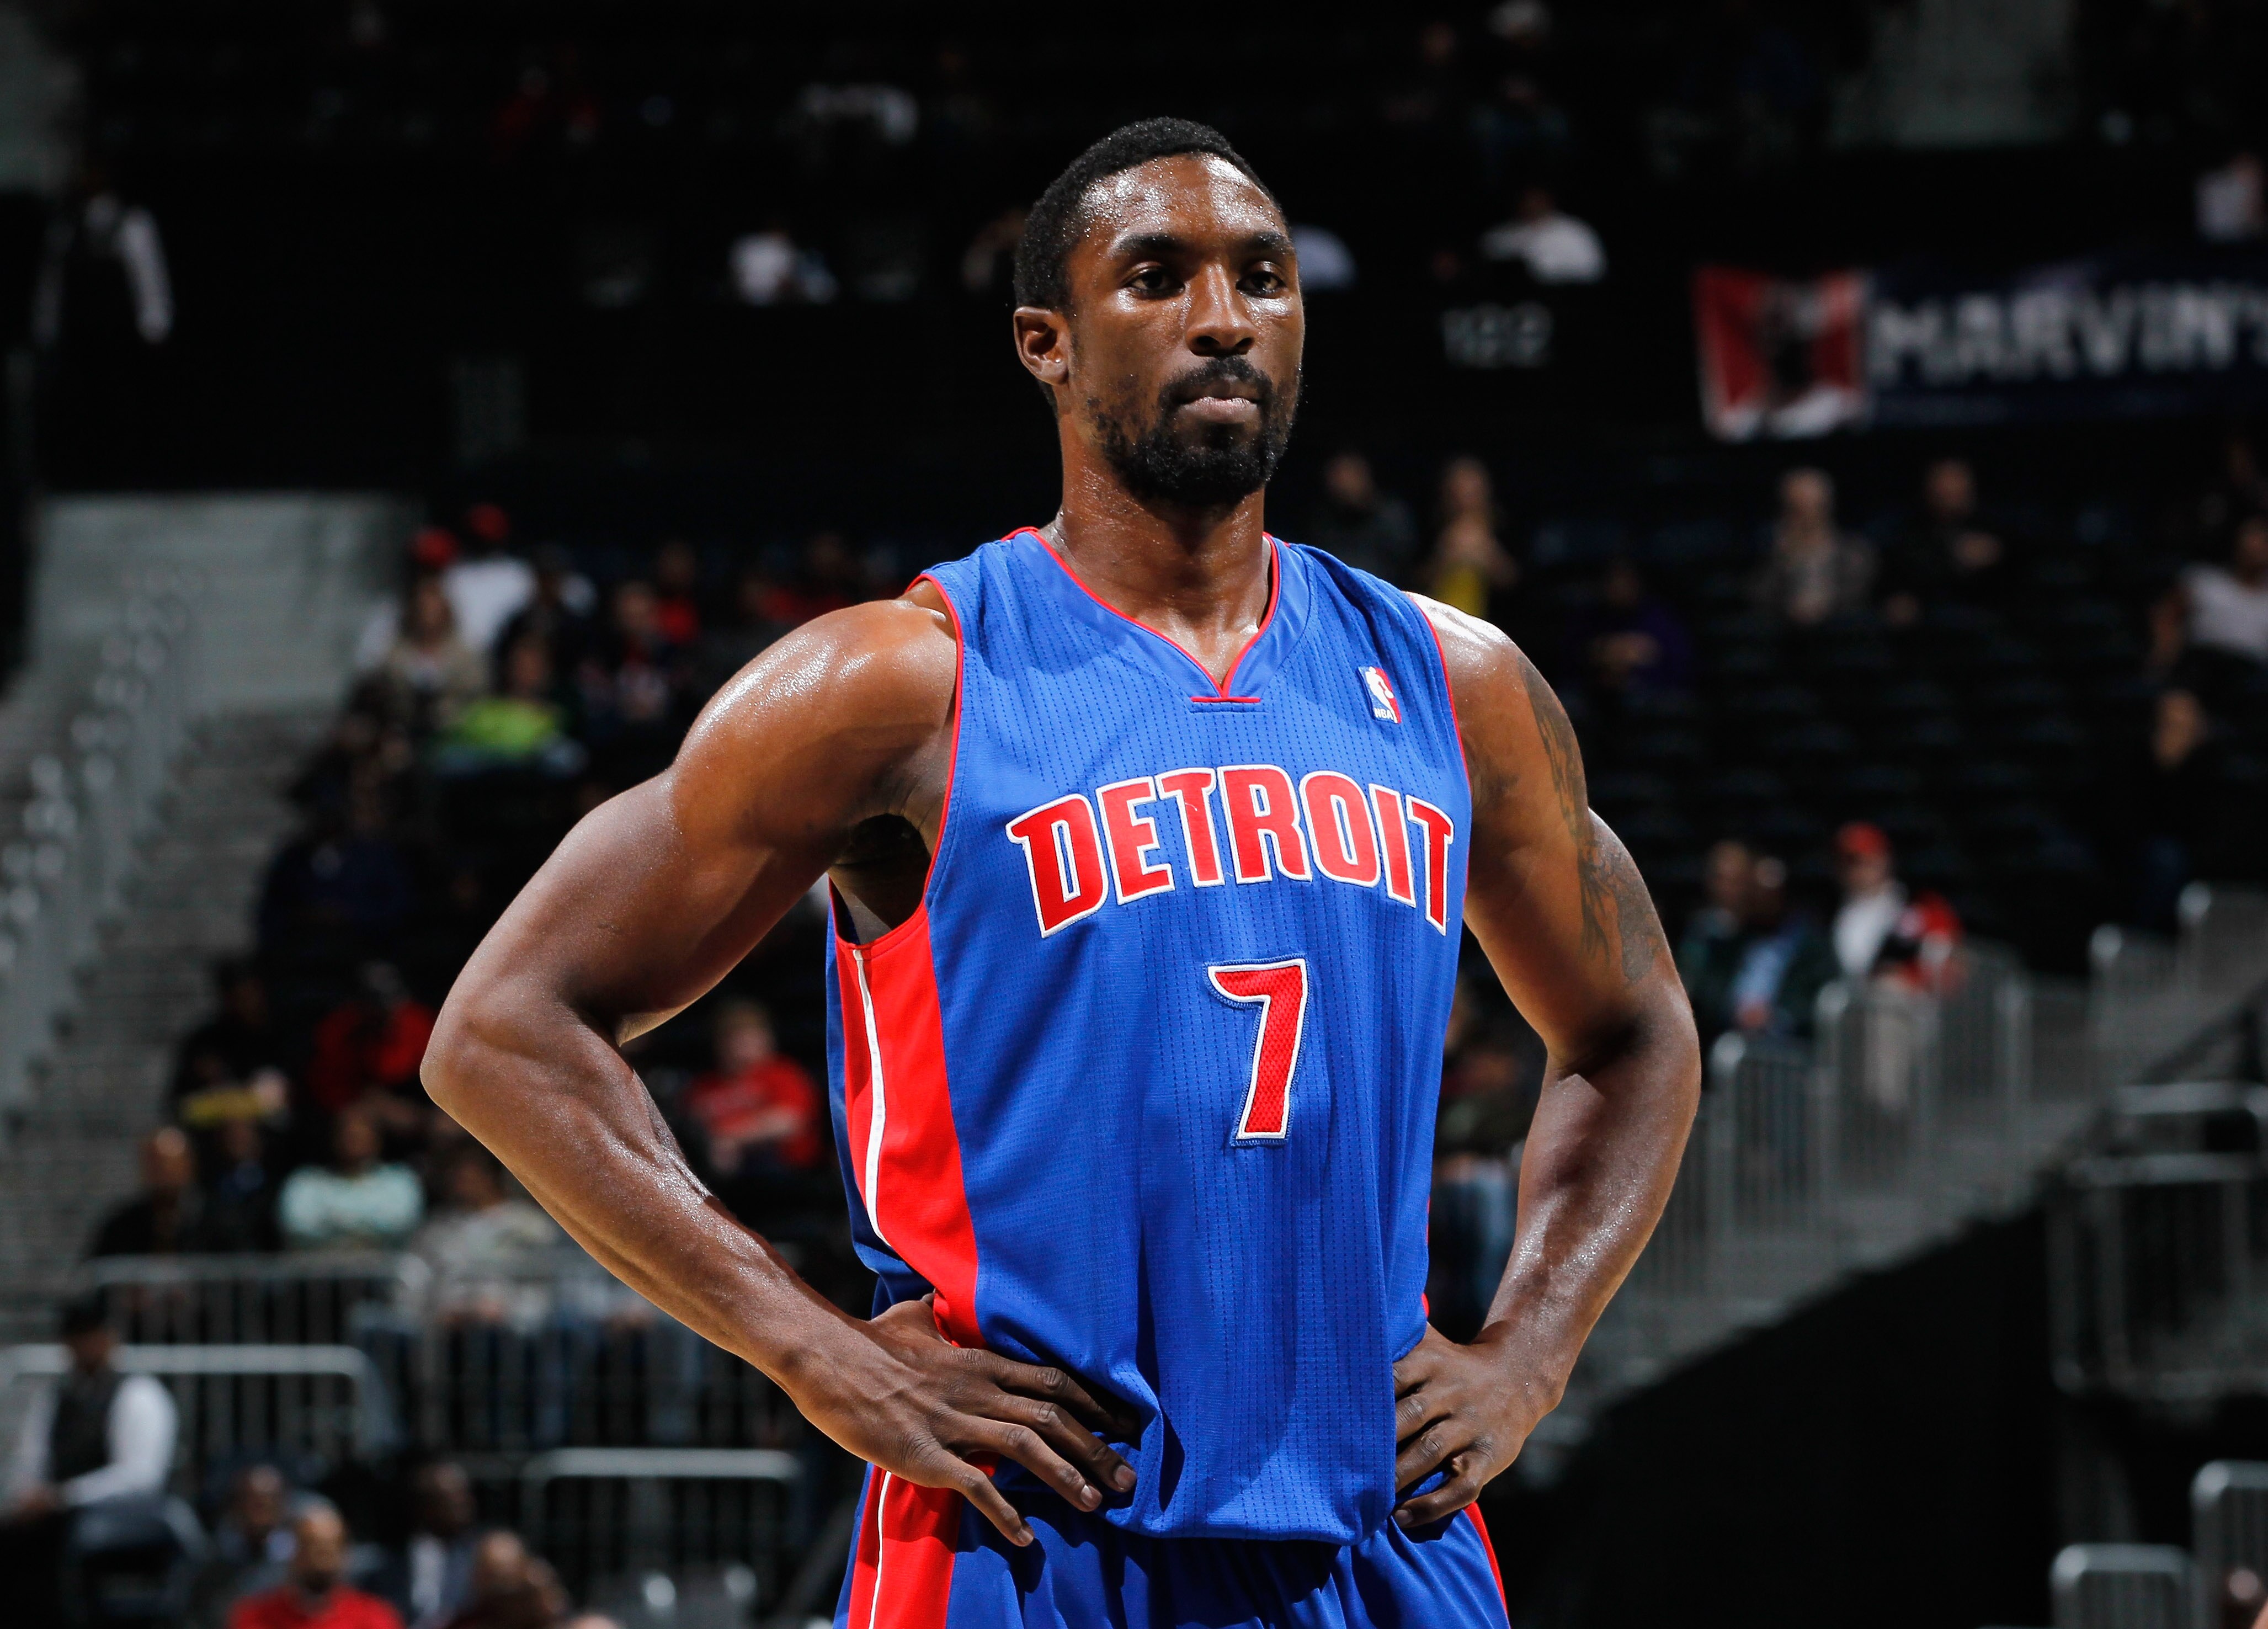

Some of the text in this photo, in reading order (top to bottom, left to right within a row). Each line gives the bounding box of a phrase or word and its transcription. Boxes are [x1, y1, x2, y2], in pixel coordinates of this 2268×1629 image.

[1374, 707, 1394, 720] NBA
[1006, 764, 1454, 937] DETROIT
[1208, 958, 1307, 1140] 7
